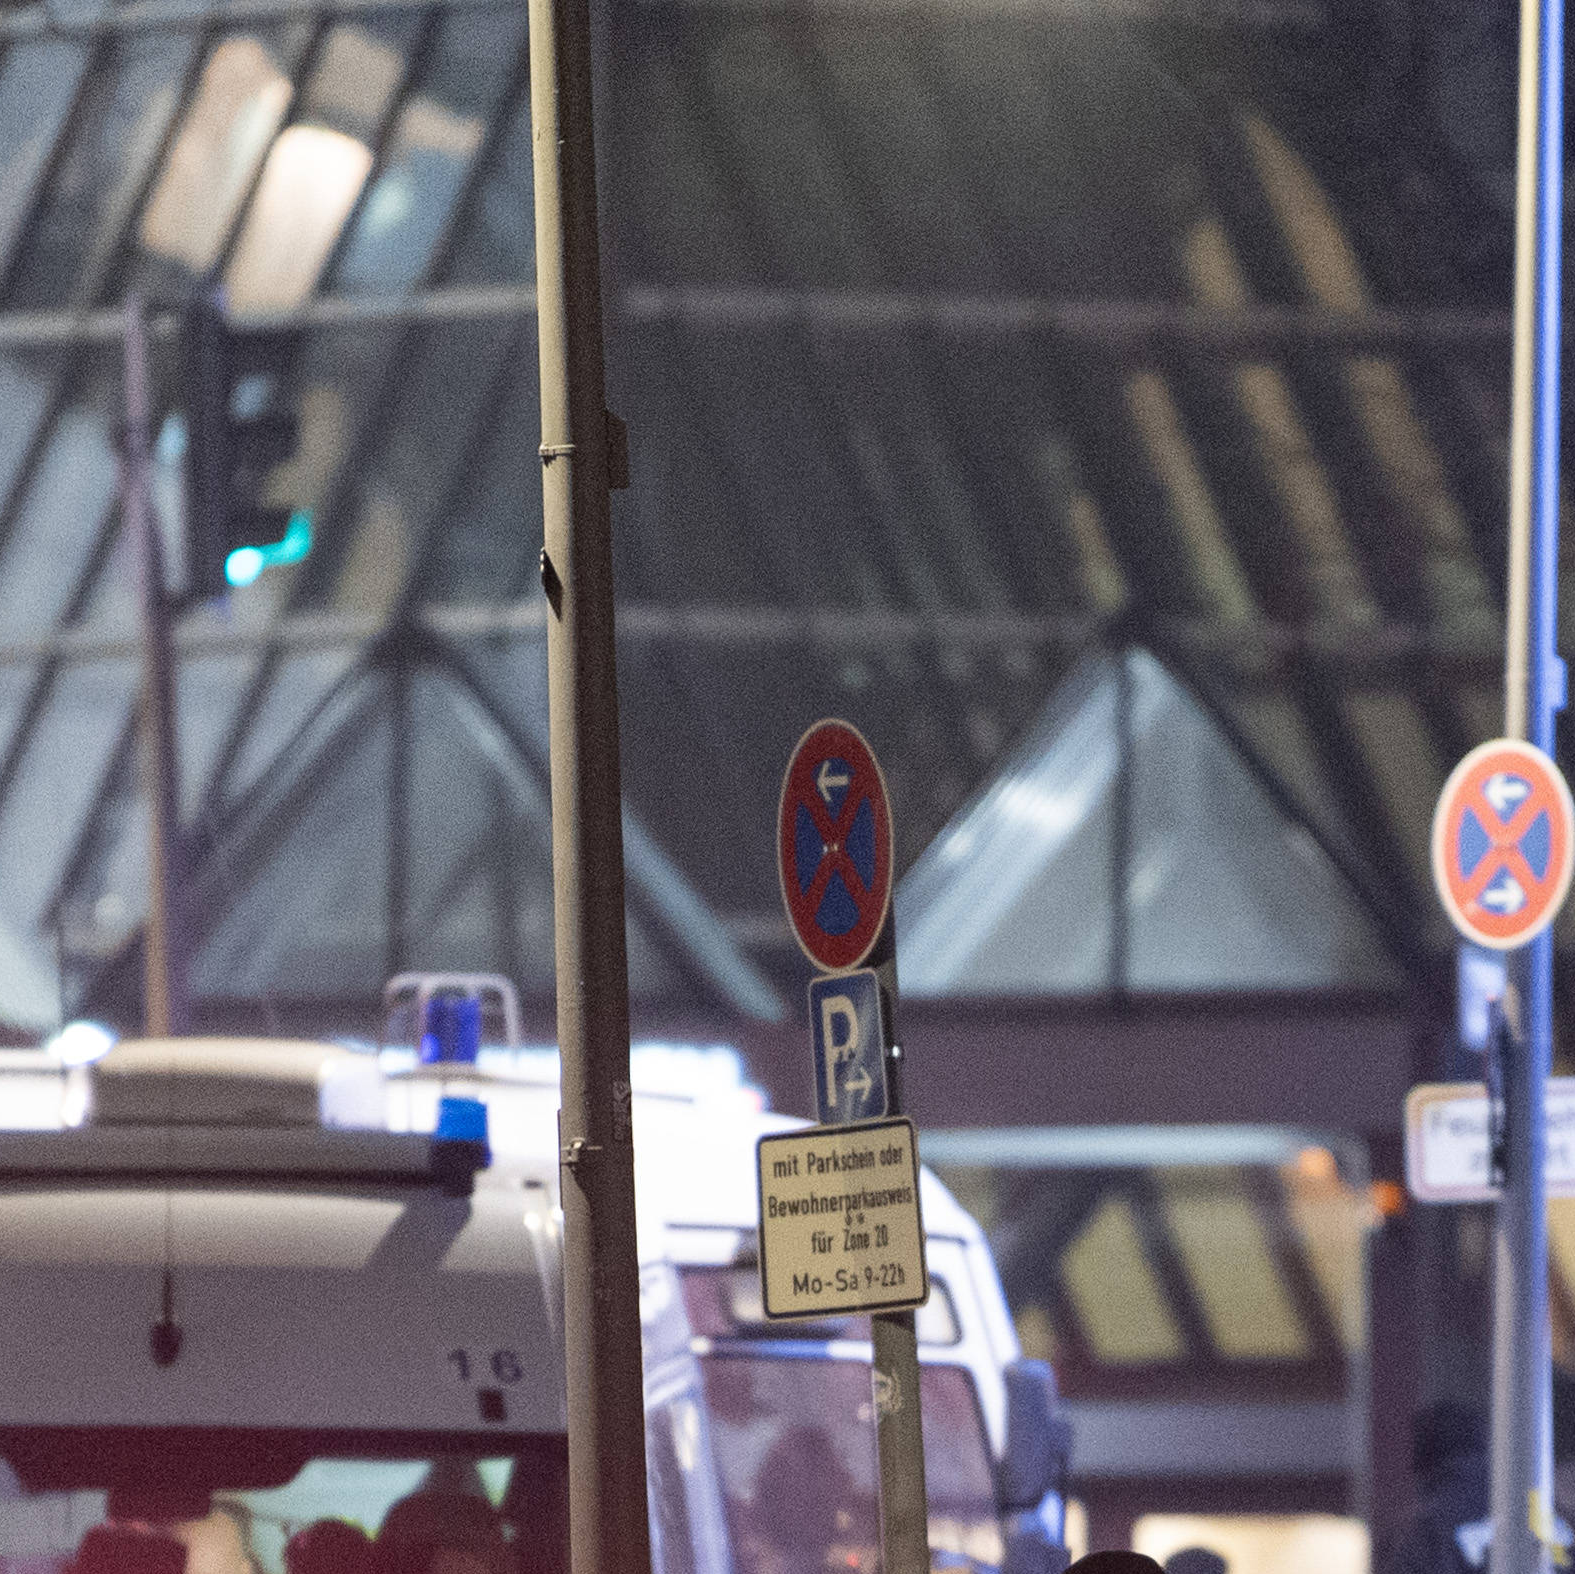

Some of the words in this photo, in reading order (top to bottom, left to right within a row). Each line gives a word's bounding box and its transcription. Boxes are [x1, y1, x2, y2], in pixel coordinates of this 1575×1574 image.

[773, 1155, 799, 1178] mit
[807, 1147, 875, 1176] Parkschein
[880, 1145, 903, 1166] oder
[768, 1186, 913, 1218] Bewohnerparkausweis
[811, 1231, 834, 1254] für
[876, 1224, 890, 1248] 20
[792, 1269, 859, 1297] Mo-Sa
[864, 1262, 906, 1288] 9-22h
[448, 1347, 525, 1386] 16
